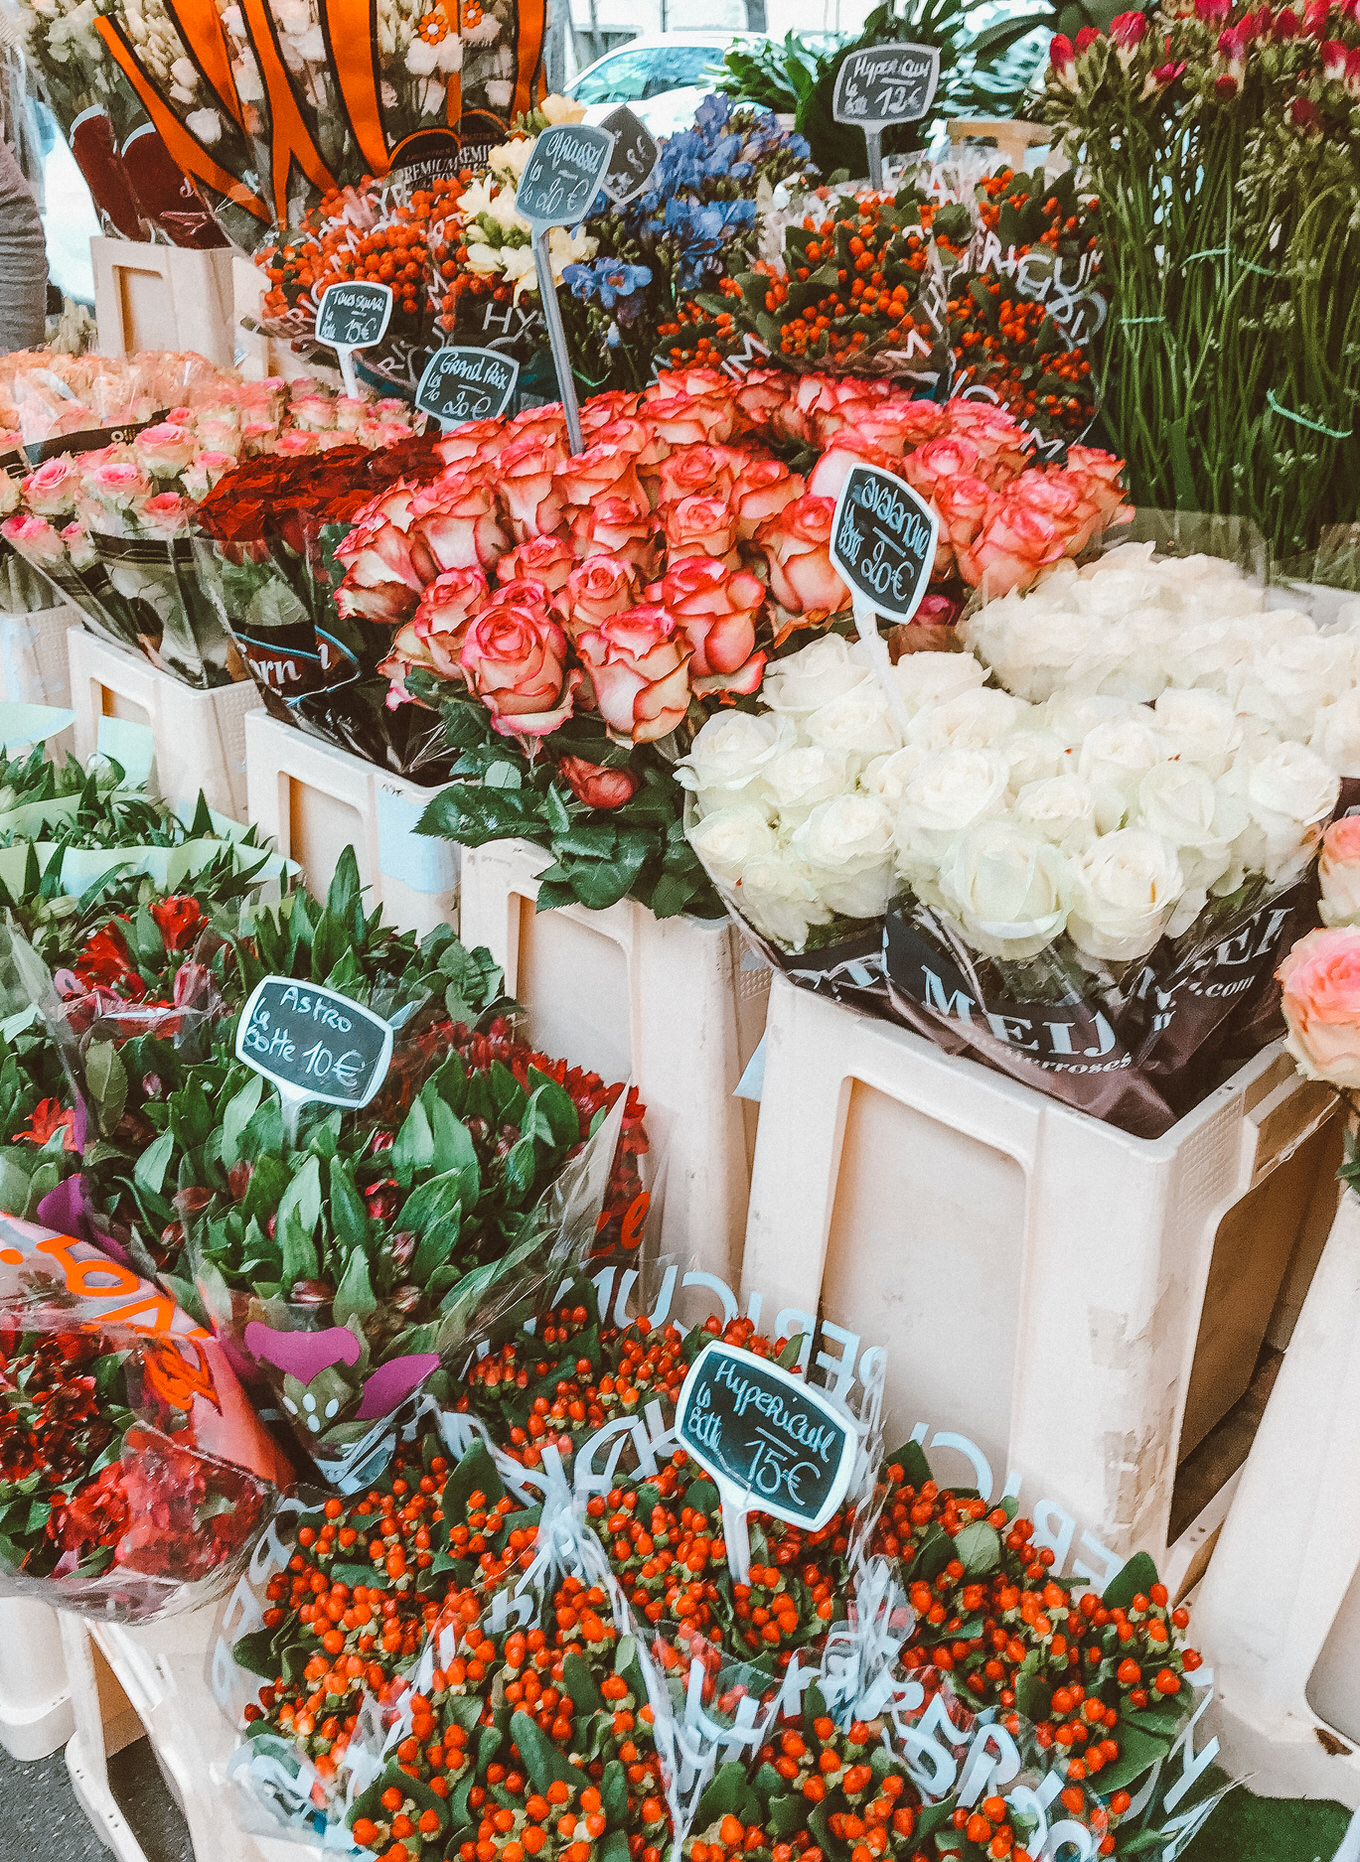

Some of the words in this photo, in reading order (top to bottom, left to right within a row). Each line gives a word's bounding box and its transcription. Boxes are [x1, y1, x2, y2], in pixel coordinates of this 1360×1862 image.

[440, 352, 482, 382] Grand
[920, 964, 1117, 1058] MEIJ
[302, 1040, 366, 1087] 10€
[744, 1440, 821, 1506] 15€
